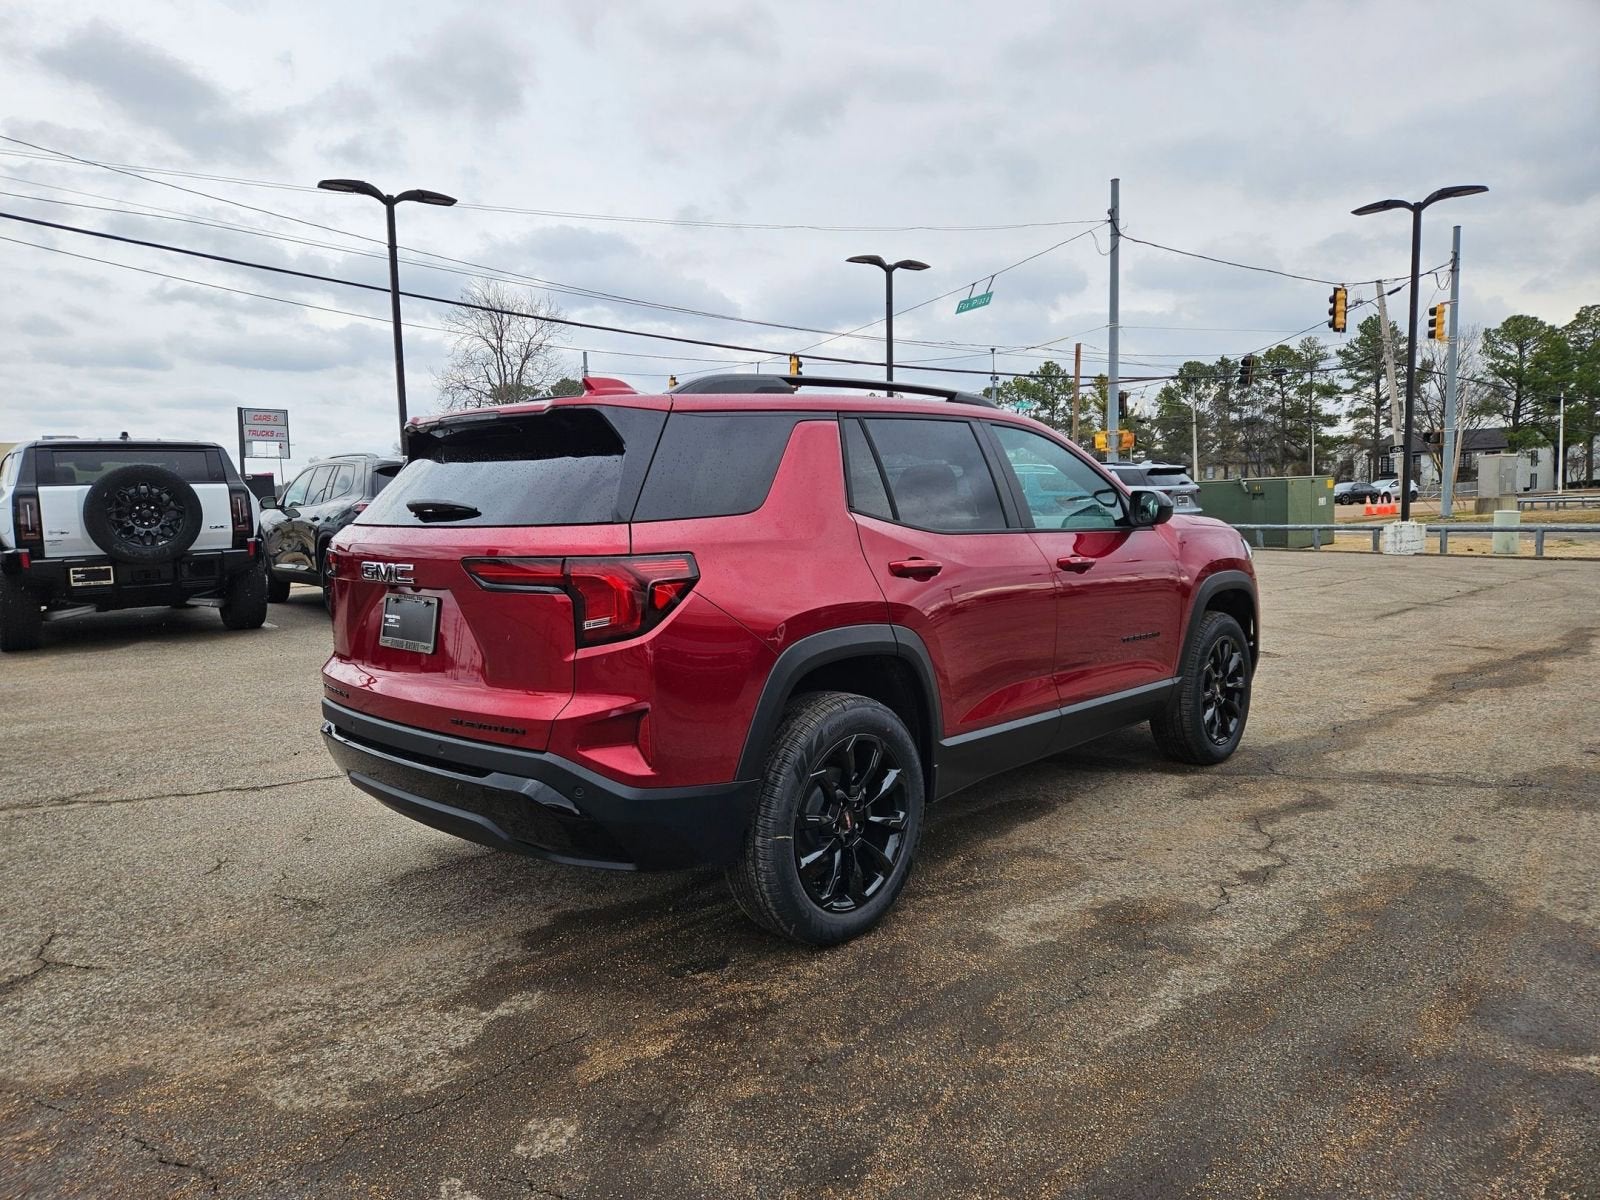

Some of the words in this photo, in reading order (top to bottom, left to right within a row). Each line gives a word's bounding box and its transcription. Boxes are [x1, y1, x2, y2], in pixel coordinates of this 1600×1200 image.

[253, 414, 271, 422] CARS
[248, 429, 274, 437] TRUCKS
[361, 561, 415, 585] GMC
